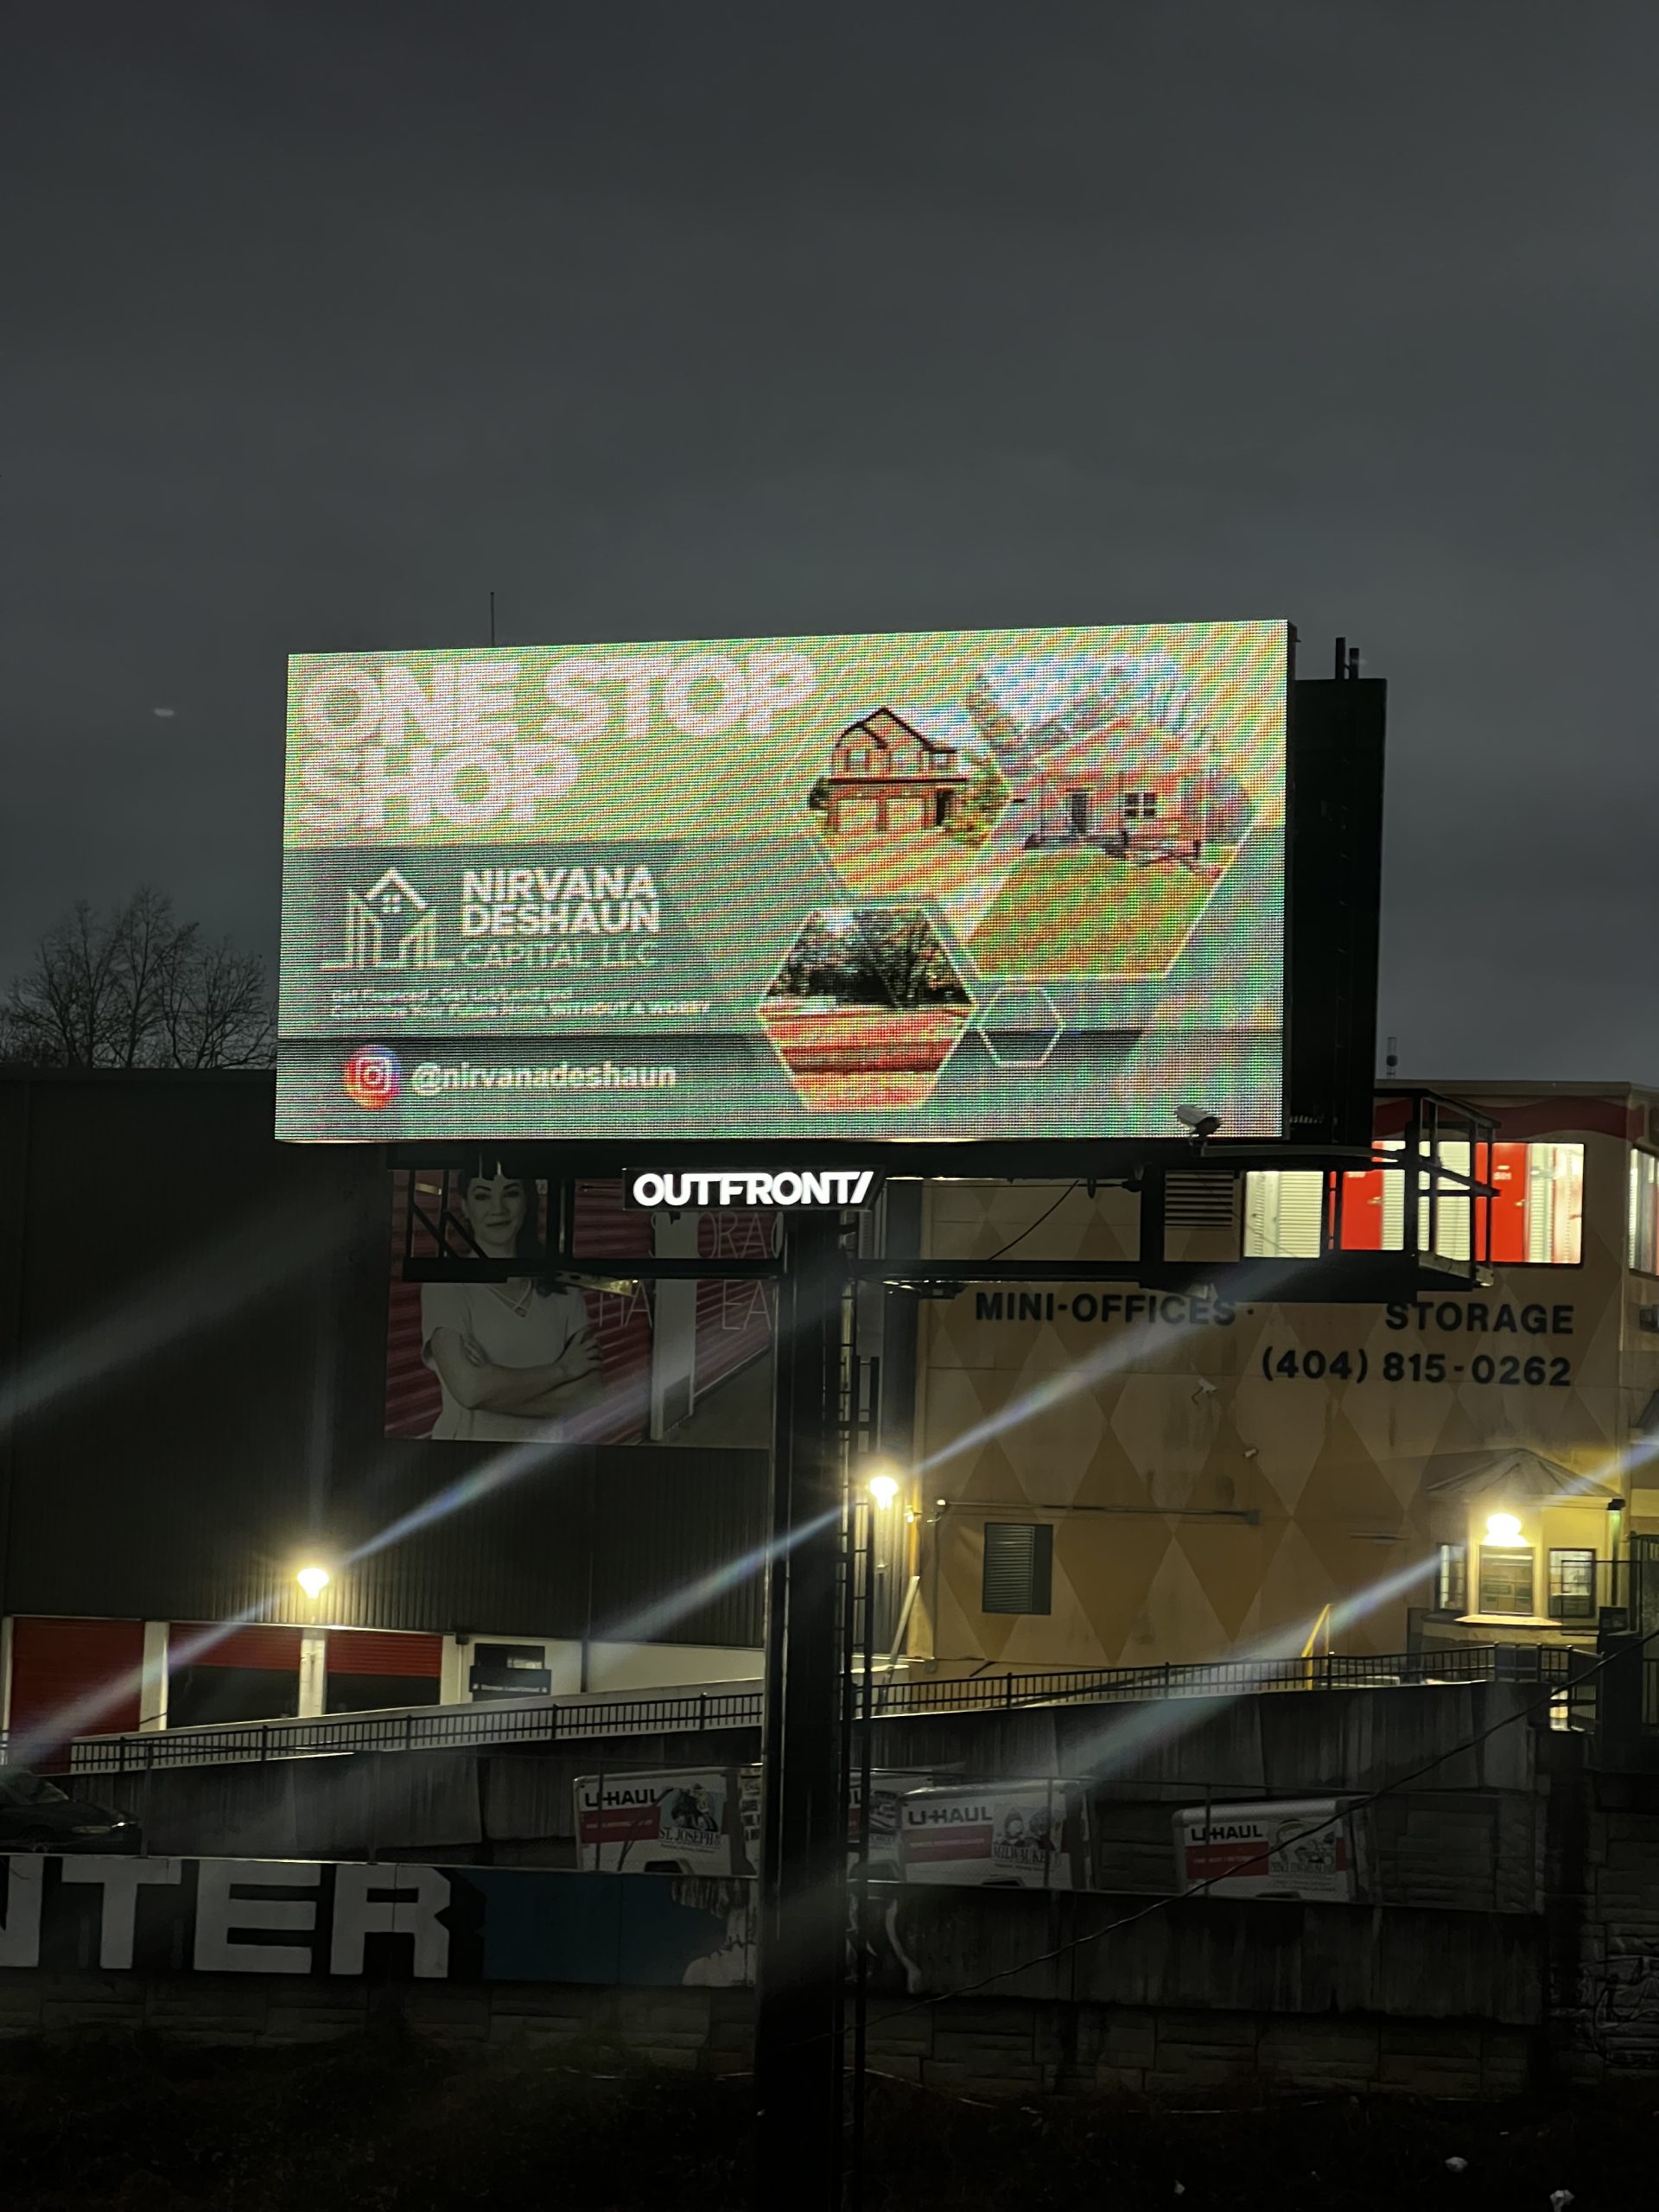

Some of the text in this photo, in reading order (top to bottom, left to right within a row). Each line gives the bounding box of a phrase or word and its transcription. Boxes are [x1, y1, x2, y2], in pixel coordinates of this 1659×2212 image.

[302, 650, 817, 747] ONE STOP
[298, 742, 580, 830] SHOP
[461, 865, 658, 903] NIRVANA
[461, 900, 660, 936] DESHAUN
[461, 940, 660, 969] CAPITAL LLC
[332, 989, 358, 1002] Get
[362, 988, 429, 1002] Financed
[440, 987, 467, 1001] Get
[543, 987, 573, 1001] and
[410, 1004, 445, 1018] Your
[448, 1003, 497, 1018] Future
[501, 1002, 545, 1017] Home
[549, 1001, 628, 1016] WITHOUT
[632, 1001, 645, 1015] A
[648, 1000, 711, 1014] WORRY
[411, 1061, 677, 1096] @nirvanadeshaun
[976, 1293, 1574, 1334] MINI-OFFICES STORAGE
[1262, 1346, 1368, 1383] (404)
[585, 1789, 659, 1808] U-HAUL
[907, 1806, 994, 1825] U-HAUL
[1191, 1824, 1263, 1841] U-HAUL
